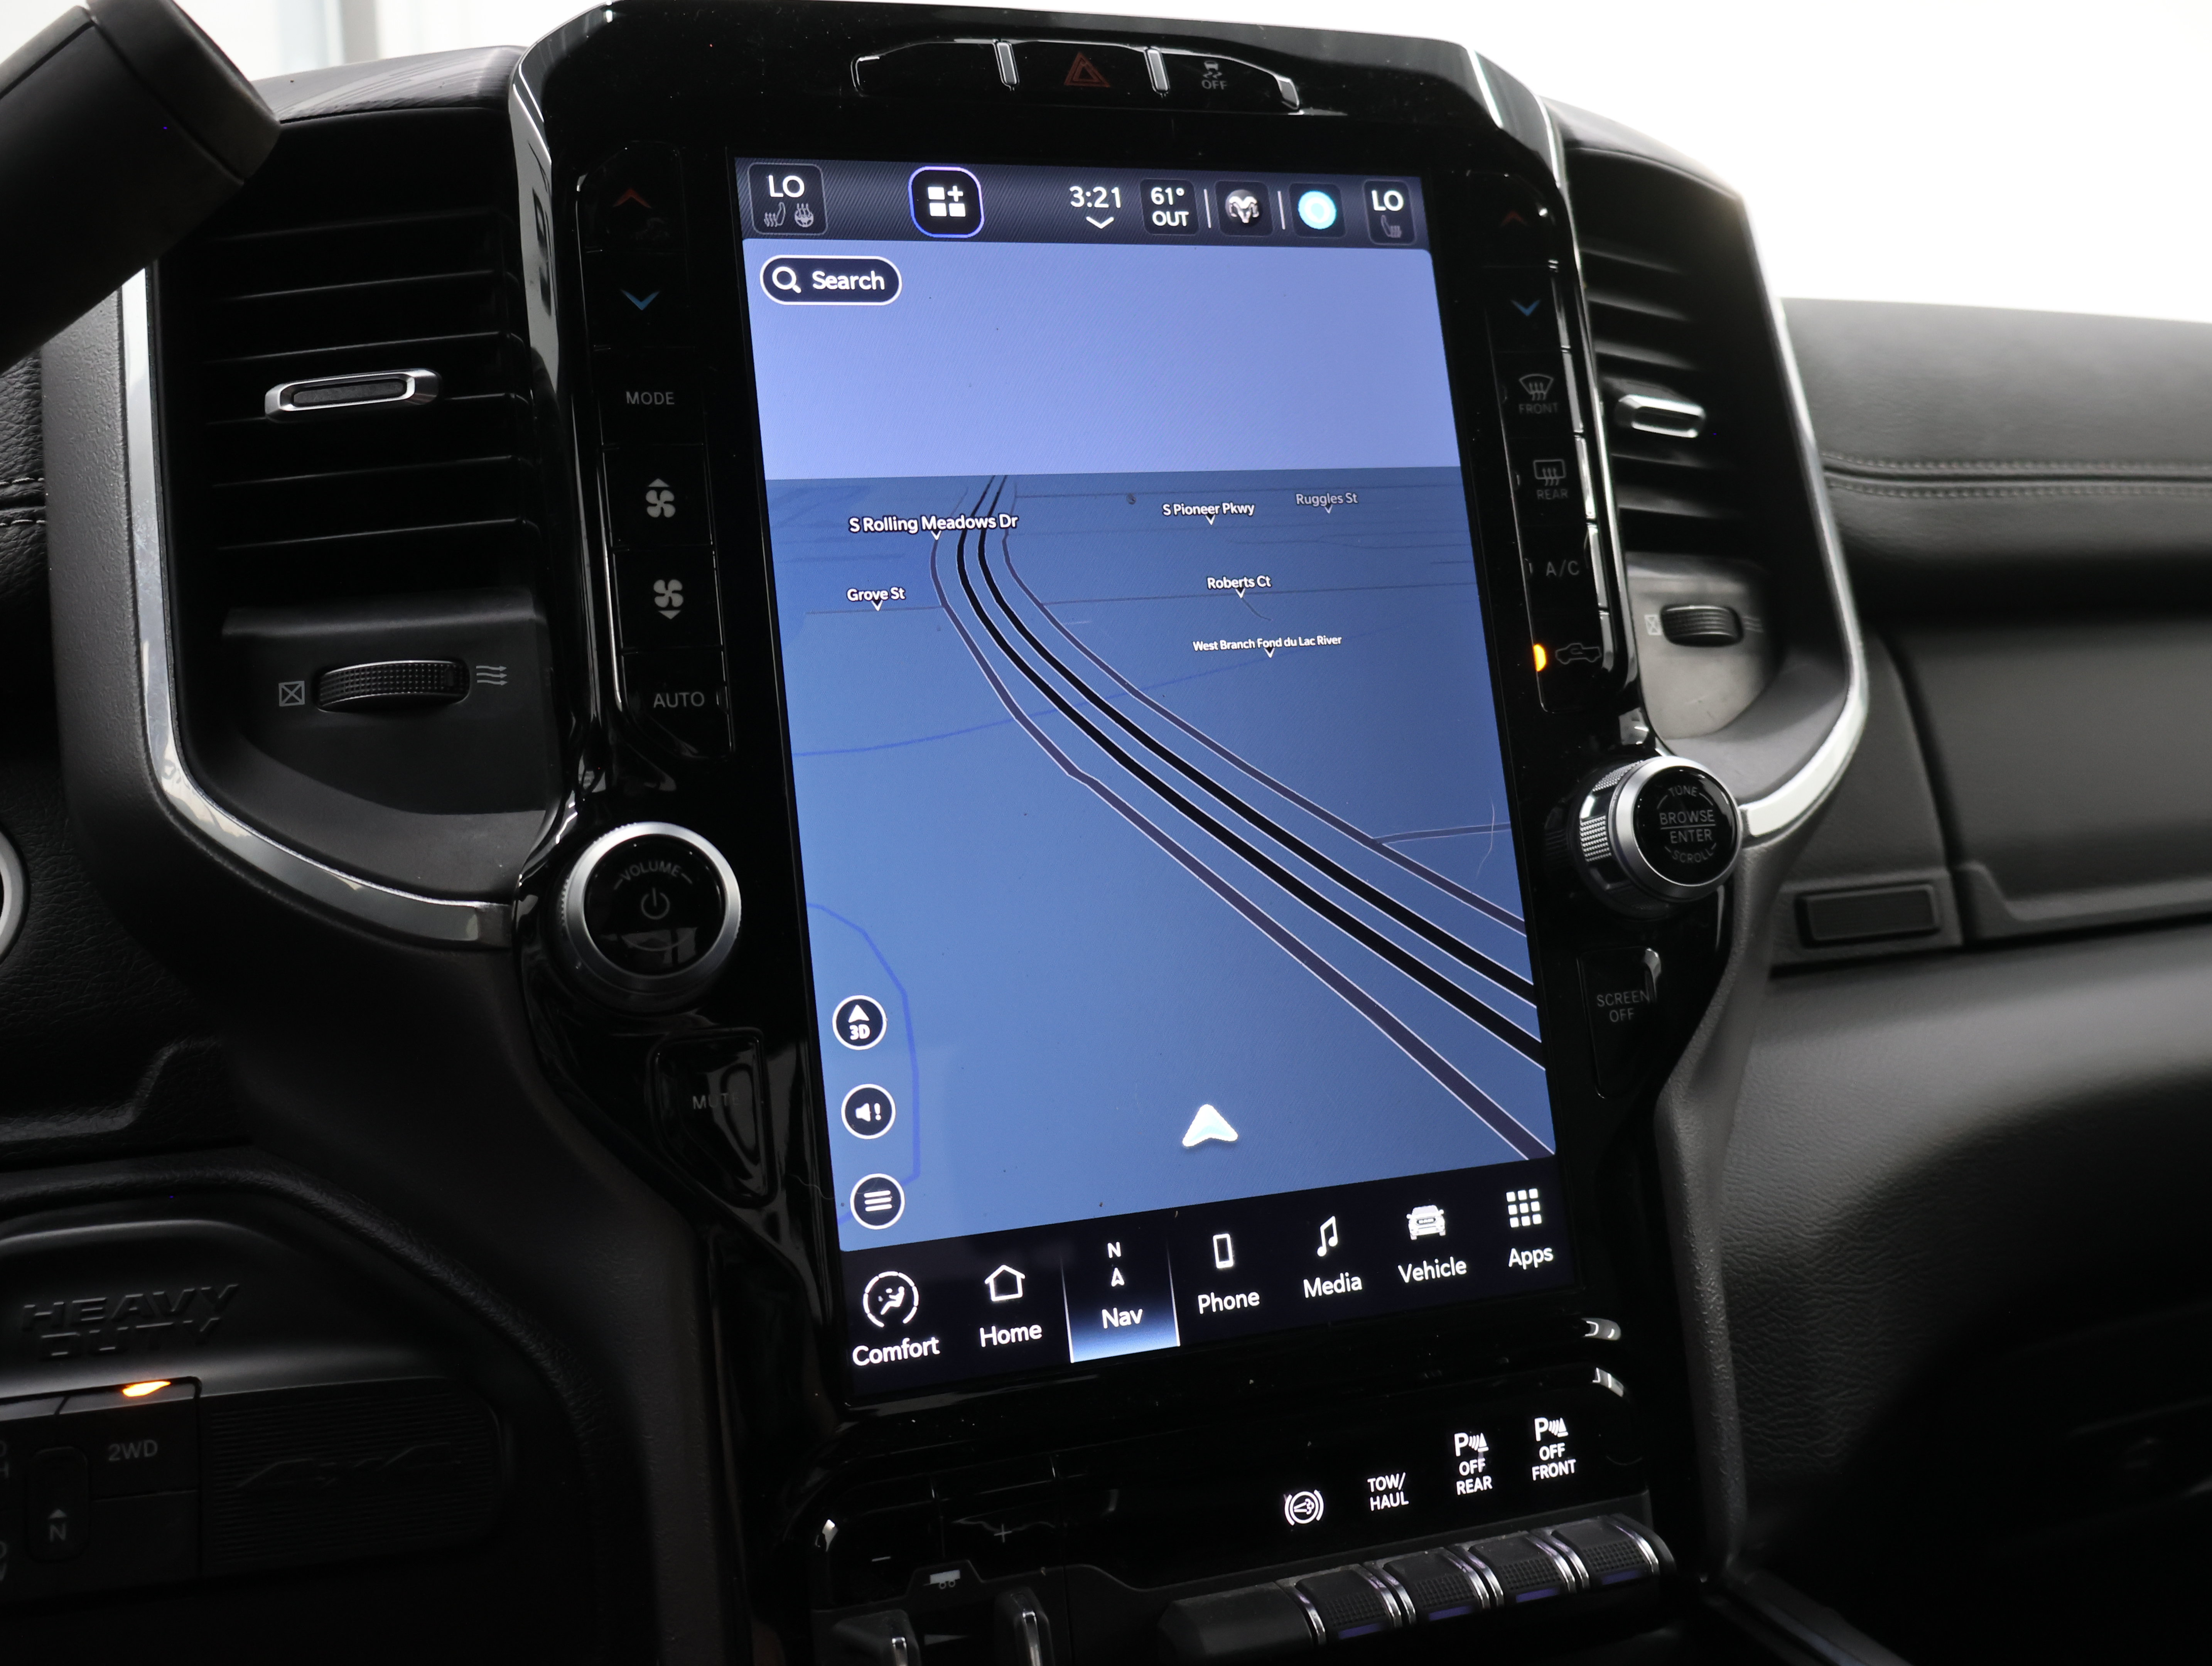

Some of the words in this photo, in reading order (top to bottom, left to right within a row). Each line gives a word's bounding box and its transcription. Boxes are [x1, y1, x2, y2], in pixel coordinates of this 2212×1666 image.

[1201, 78, 1227, 91] OFF
[768, 175, 805, 198] LO
[1151, 187, 1185, 205] 61°
[1070, 186, 1122, 208] 3:21
[1372, 190, 1404, 212] LO
[1152, 210, 1189, 227] OUT
[812, 270, 885, 292] Search
[626, 391, 675, 406] MODE
[1519, 403, 1559, 415] FRONT
[1296, 493, 1343, 507] Ruggles
[1345, 492, 1358, 504] St
[1536, 488, 1568, 500] REAR
[1163, 504, 1172, 516] S
[1174, 503, 1220, 516] Pioneer
[1222, 502, 1255, 516] Pkwy
[849, 518, 861, 532] S
[863, 516, 918, 534] Rolling
[921, 514, 996, 530] Meadows
[999, 514, 1018, 528] Dr
[1545, 560, 1580, 577] A/C
[1207, 577, 1255, 589] Roberts
[1257, 575, 1272, 587] Ct
[847, 588, 888, 601] Grove
[891, 587, 906, 600] St
[1192, 641, 1218, 651] West
[1220, 639, 1255, 650] Branch
[1257, 637, 1282, 648] Fond
[1284, 636, 1297, 647] du
[1298, 636, 1316, 646] Lac
[1316, 635, 1342, 646] River
[653, 692, 705, 710] AUTO
[1659, 809, 1715, 826] BROWSE
[1670, 828, 1713, 844] ENTER
[1672, 849, 1714, 864] SCROLL
[620, 860, 683, 882] VOLUME
[1596, 990, 1650, 1007] SCREEN
[1609, 1008, 1635, 1023] OFF
[849, 1024, 871, 1040] 3D
[1508, 1245, 1554, 1270] Apps
[1398, 1256, 1467, 1283] Vehicle
[1303, 1272, 1363, 1298] Media
[22, 1284, 239, 1331] HEAVY
[1197, 1290, 1260, 1314] Phone
[1102, 1307, 1143, 1329] Nav
[39, 1316, 221, 1361] DUTY
[979, 1324, 1043, 1347] Home
[852, 1336, 941, 1366] Comfort
[108, 1439, 159, 1463] 2WD
[1539, 1442, 1566, 1460] OFF
[1459, 1458, 1486, 1477] OFF
[1532, 1459, 1576, 1481] FRONT
[1367, 1472, 1406, 1493] TOW/
[1456, 1475, 1493, 1496] REAR
[1370, 1491, 1409, 1511] HAUL
[49, 1522, 67, 1543] N
